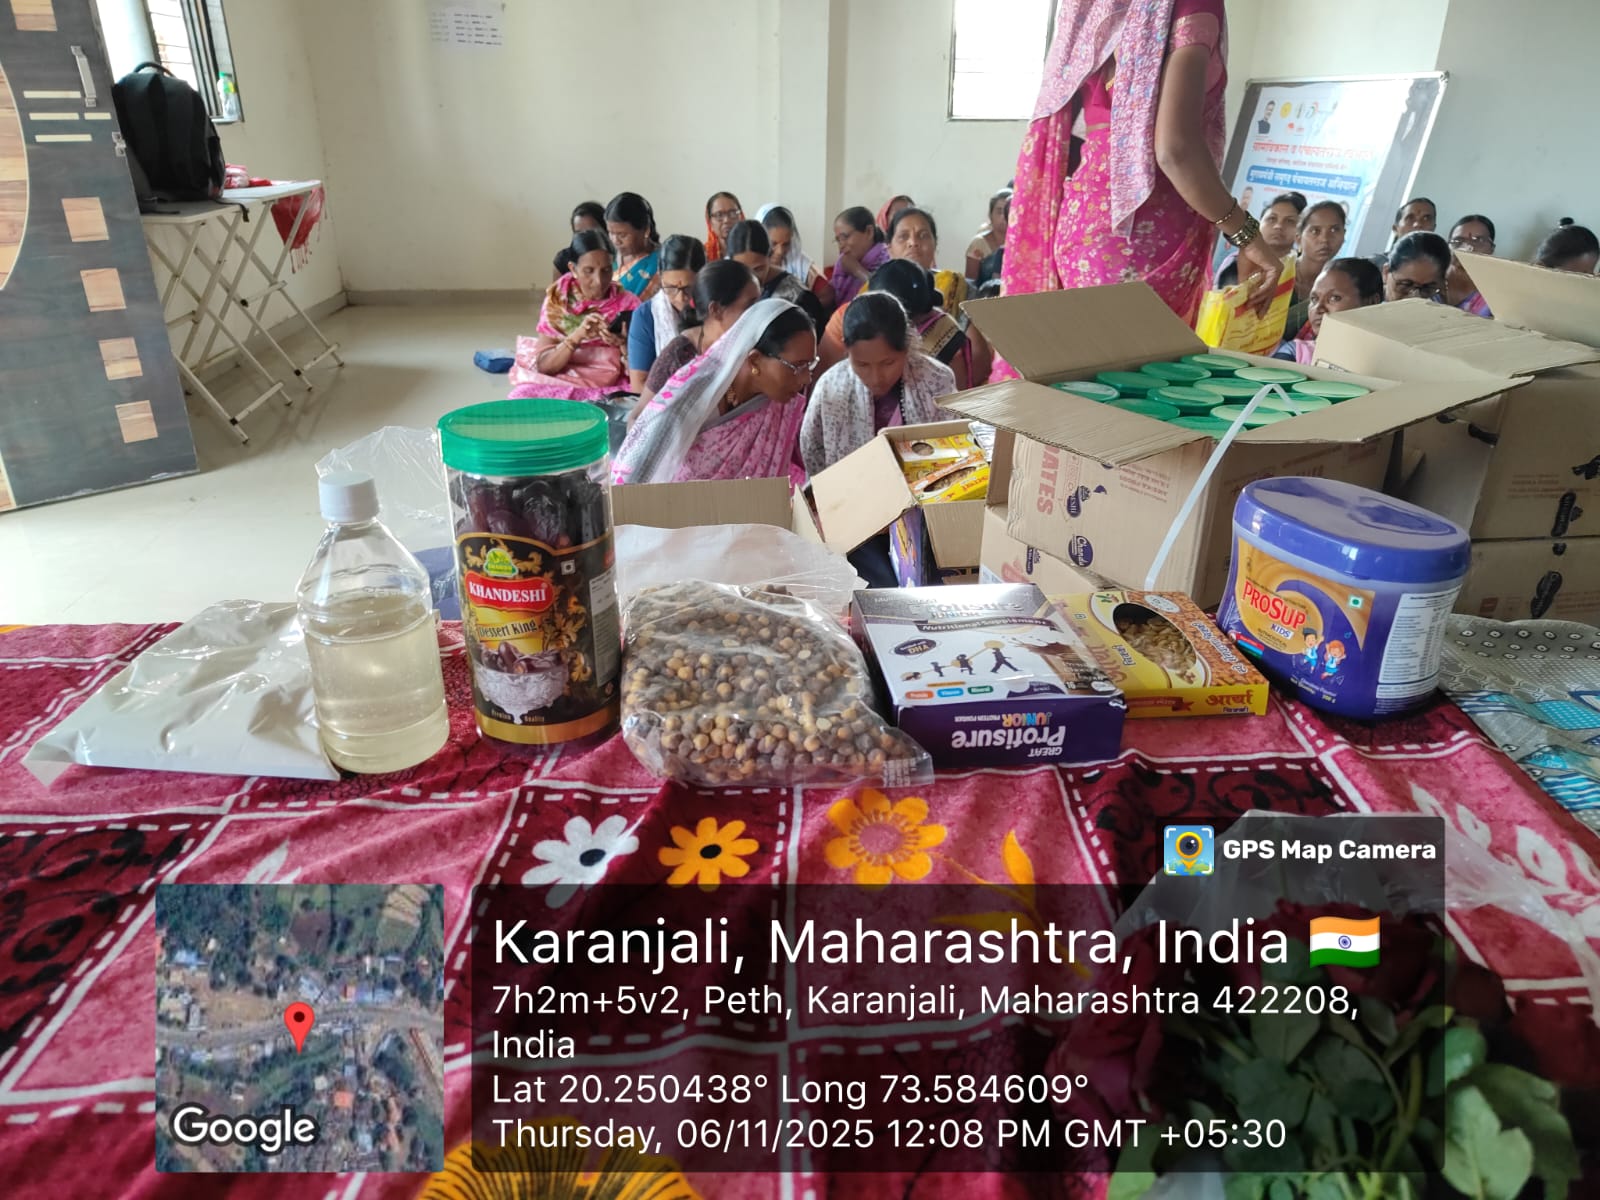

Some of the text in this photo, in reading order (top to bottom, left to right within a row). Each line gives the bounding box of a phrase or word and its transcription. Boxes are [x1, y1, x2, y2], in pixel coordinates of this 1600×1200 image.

[468, 581, 546, 602] KHANDESHI
[479, 619, 538, 639] Dessert King
[922, 620, 981, 631] Nutritional
[1271, 623, 1292, 639] KIDS
[1001, 711, 1053, 727] JUNIOR
[951, 725, 1066, 750] Protisure
[1028, 746, 1063, 757] GREAT
